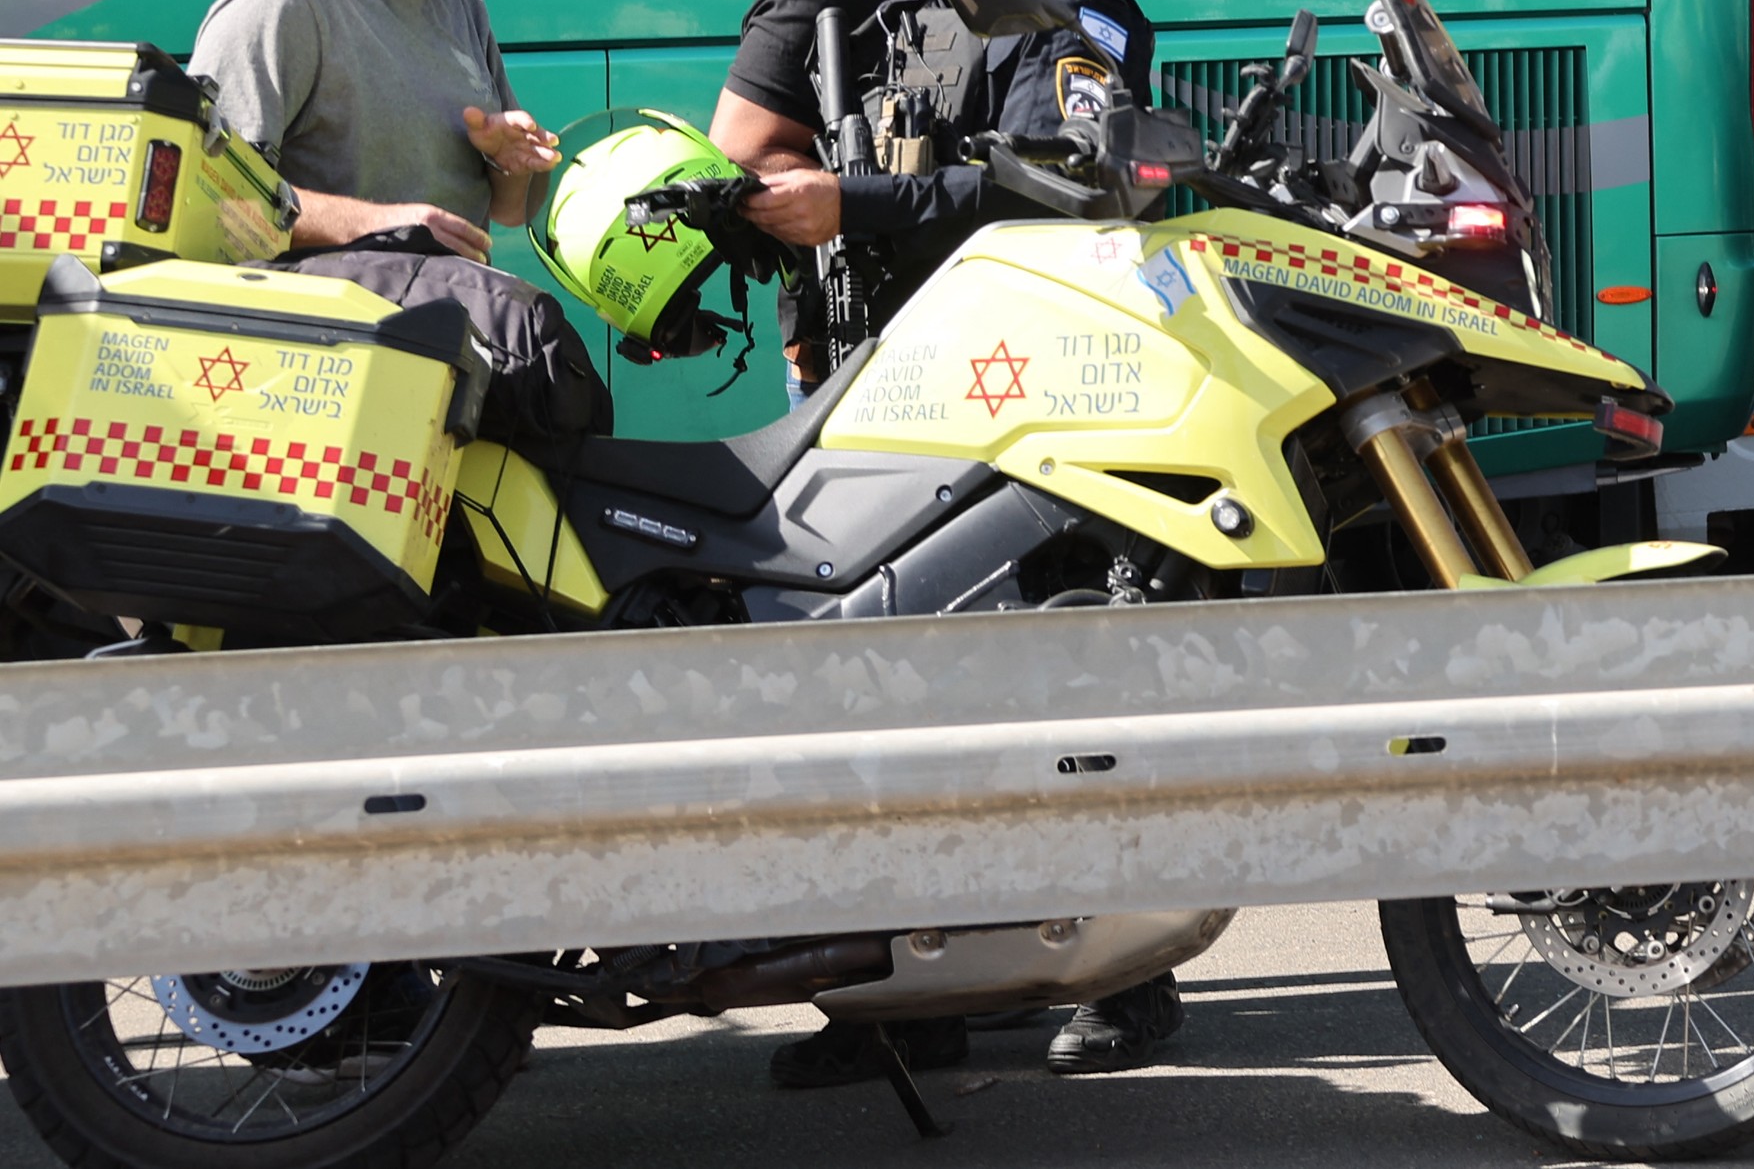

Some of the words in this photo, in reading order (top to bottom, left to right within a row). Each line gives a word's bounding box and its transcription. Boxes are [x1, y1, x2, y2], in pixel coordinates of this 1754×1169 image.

[57, 122, 92, 140] דוד
[99, 123, 135, 144] מגן
[77, 145, 132, 164] אדום
[43, 162, 127, 186] בישראל
[596, 265, 616, 296] MAGEN
[607, 276, 624, 302] DAVID
[630, 274, 655, 306] ISRAEL
[617, 281, 635, 308] ADOM
[1223, 258, 1290, 286] MAGEN
[1296, 273, 1351, 298] DAVID
[1356, 287, 1412, 316] ADOM
[1416, 301, 1437, 320] IN
[1442, 307, 1500, 336] ISRAEL
[627, 302, 638, 316] IN
[101, 331, 170, 352] MAGEN
[1056, 334, 1095, 357] דוד
[1105, 332, 1141, 360] מגן
[97, 346, 155, 365] DAVID
[276, 350, 311, 370] דוד
[317, 356, 353, 376] מגן
[93, 361, 152, 381] ADOM
[1081, 361, 1142, 385] אדום
[89, 377, 111, 392] IN
[115, 379, 175, 400] ISRAEL
[293, 375, 349, 398] אדום
[860, 384, 921, 404] ADOM
[258, 389, 342, 419] בישראל
[854, 406, 875, 423] IN
[883, 402, 950, 423] ISRAEL
[1043, 389, 1140, 417] בישראל
